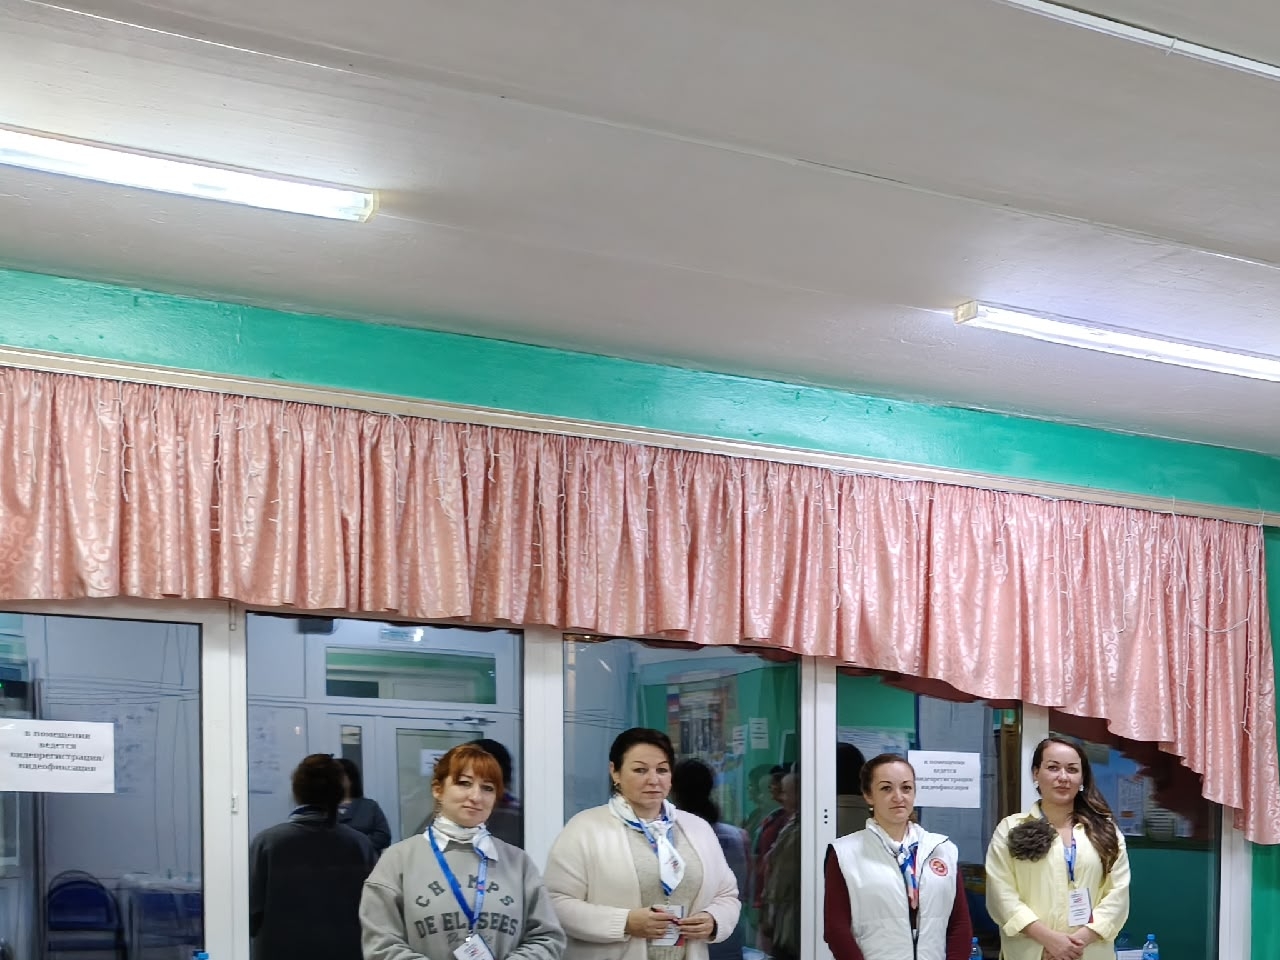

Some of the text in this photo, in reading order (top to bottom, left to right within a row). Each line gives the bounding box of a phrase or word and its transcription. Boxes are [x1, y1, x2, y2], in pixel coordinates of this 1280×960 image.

[416, 874, 514, 907] CHMPS
[414, 915, 438, 938] DE
[441, 911, 518, 936] ELSEES
